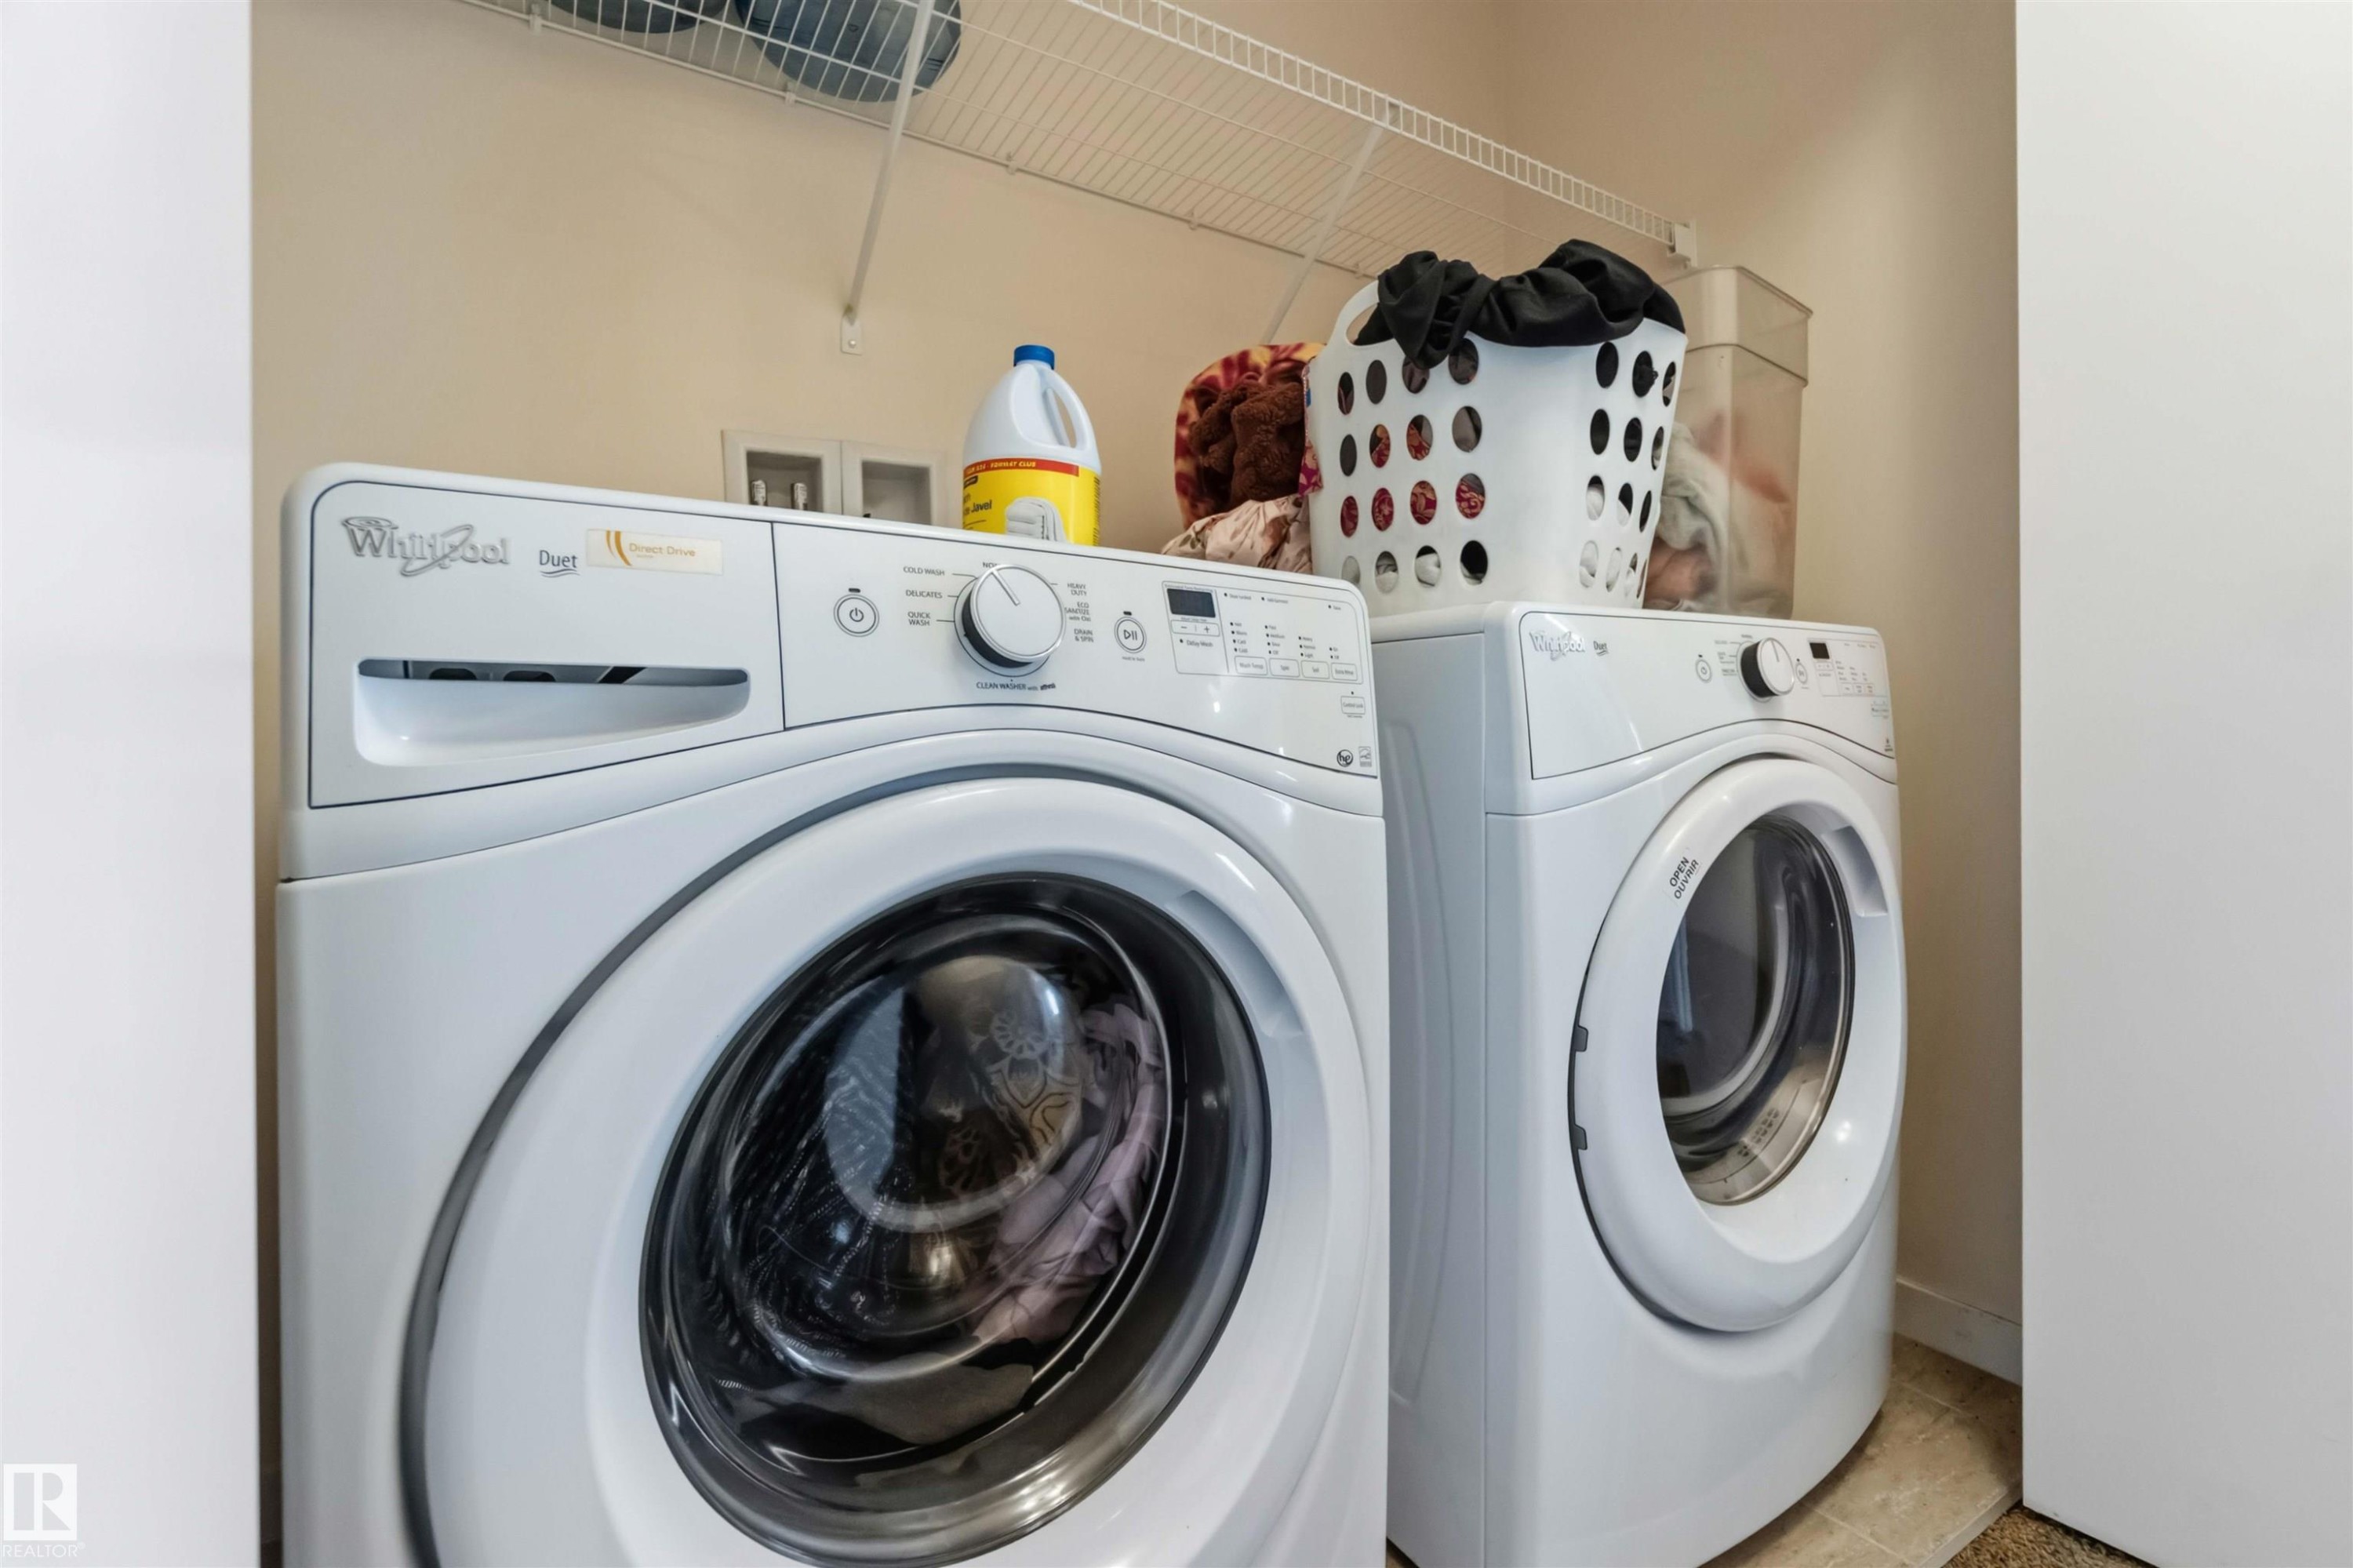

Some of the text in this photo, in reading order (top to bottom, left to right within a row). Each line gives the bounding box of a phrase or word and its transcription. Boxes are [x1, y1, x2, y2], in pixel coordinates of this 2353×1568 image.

[971, 499, 992, 513] Javel
[340, 516, 511, 577] Whirlpool
[628, 543, 664, 555] Direct
[666, 546, 696, 557] Drive
[539, 550, 578, 569] Duet
[903, 566, 923, 574] COLD
[905, 589, 943, 598] DELICATES
[1669, 857, 1690, 887] OPEN
[1674, 859, 1699, 900] OUVRIR
